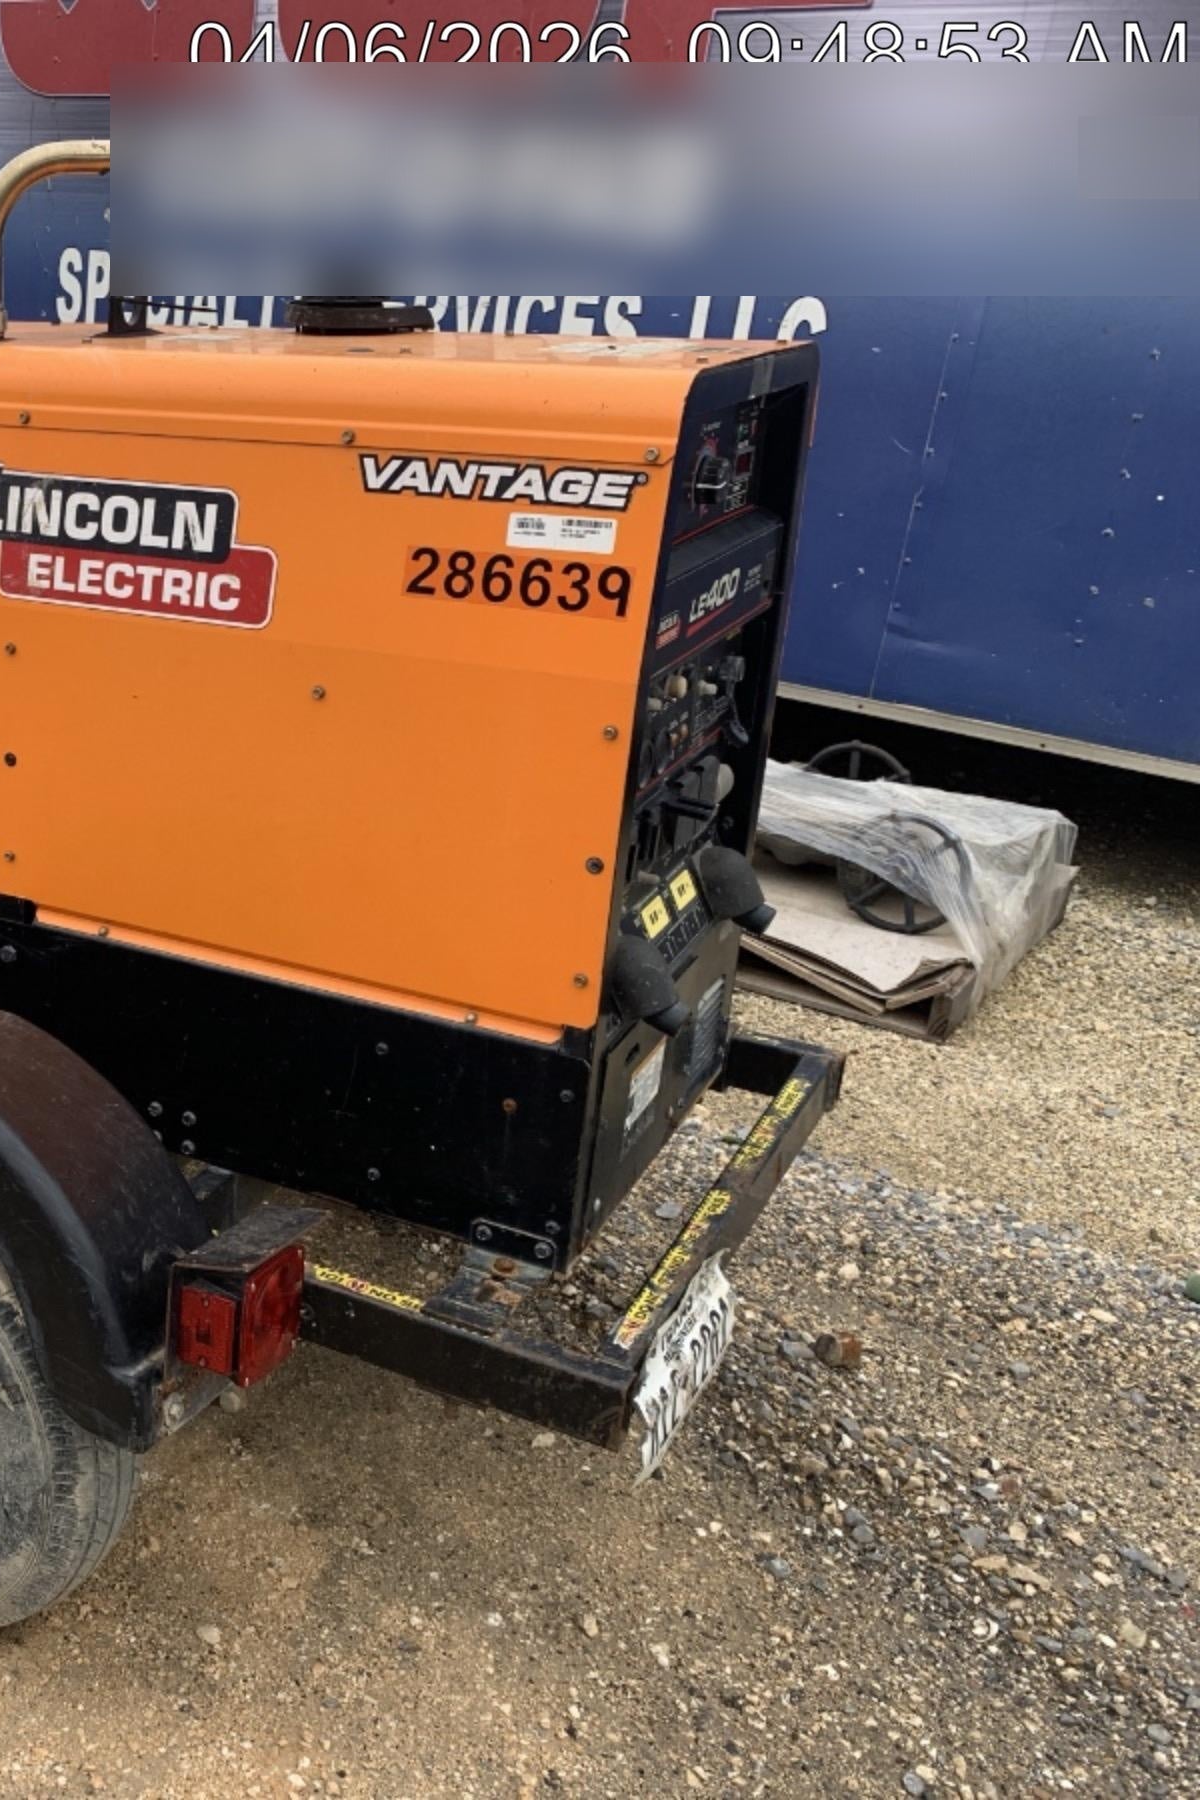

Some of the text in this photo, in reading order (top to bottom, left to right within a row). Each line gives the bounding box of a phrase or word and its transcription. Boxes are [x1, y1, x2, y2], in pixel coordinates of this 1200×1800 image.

[362, 456, 635, 508] VANTAGE
[27, 552, 242, 612] ELECTRIC
[405, 547, 632, 618] 286639
